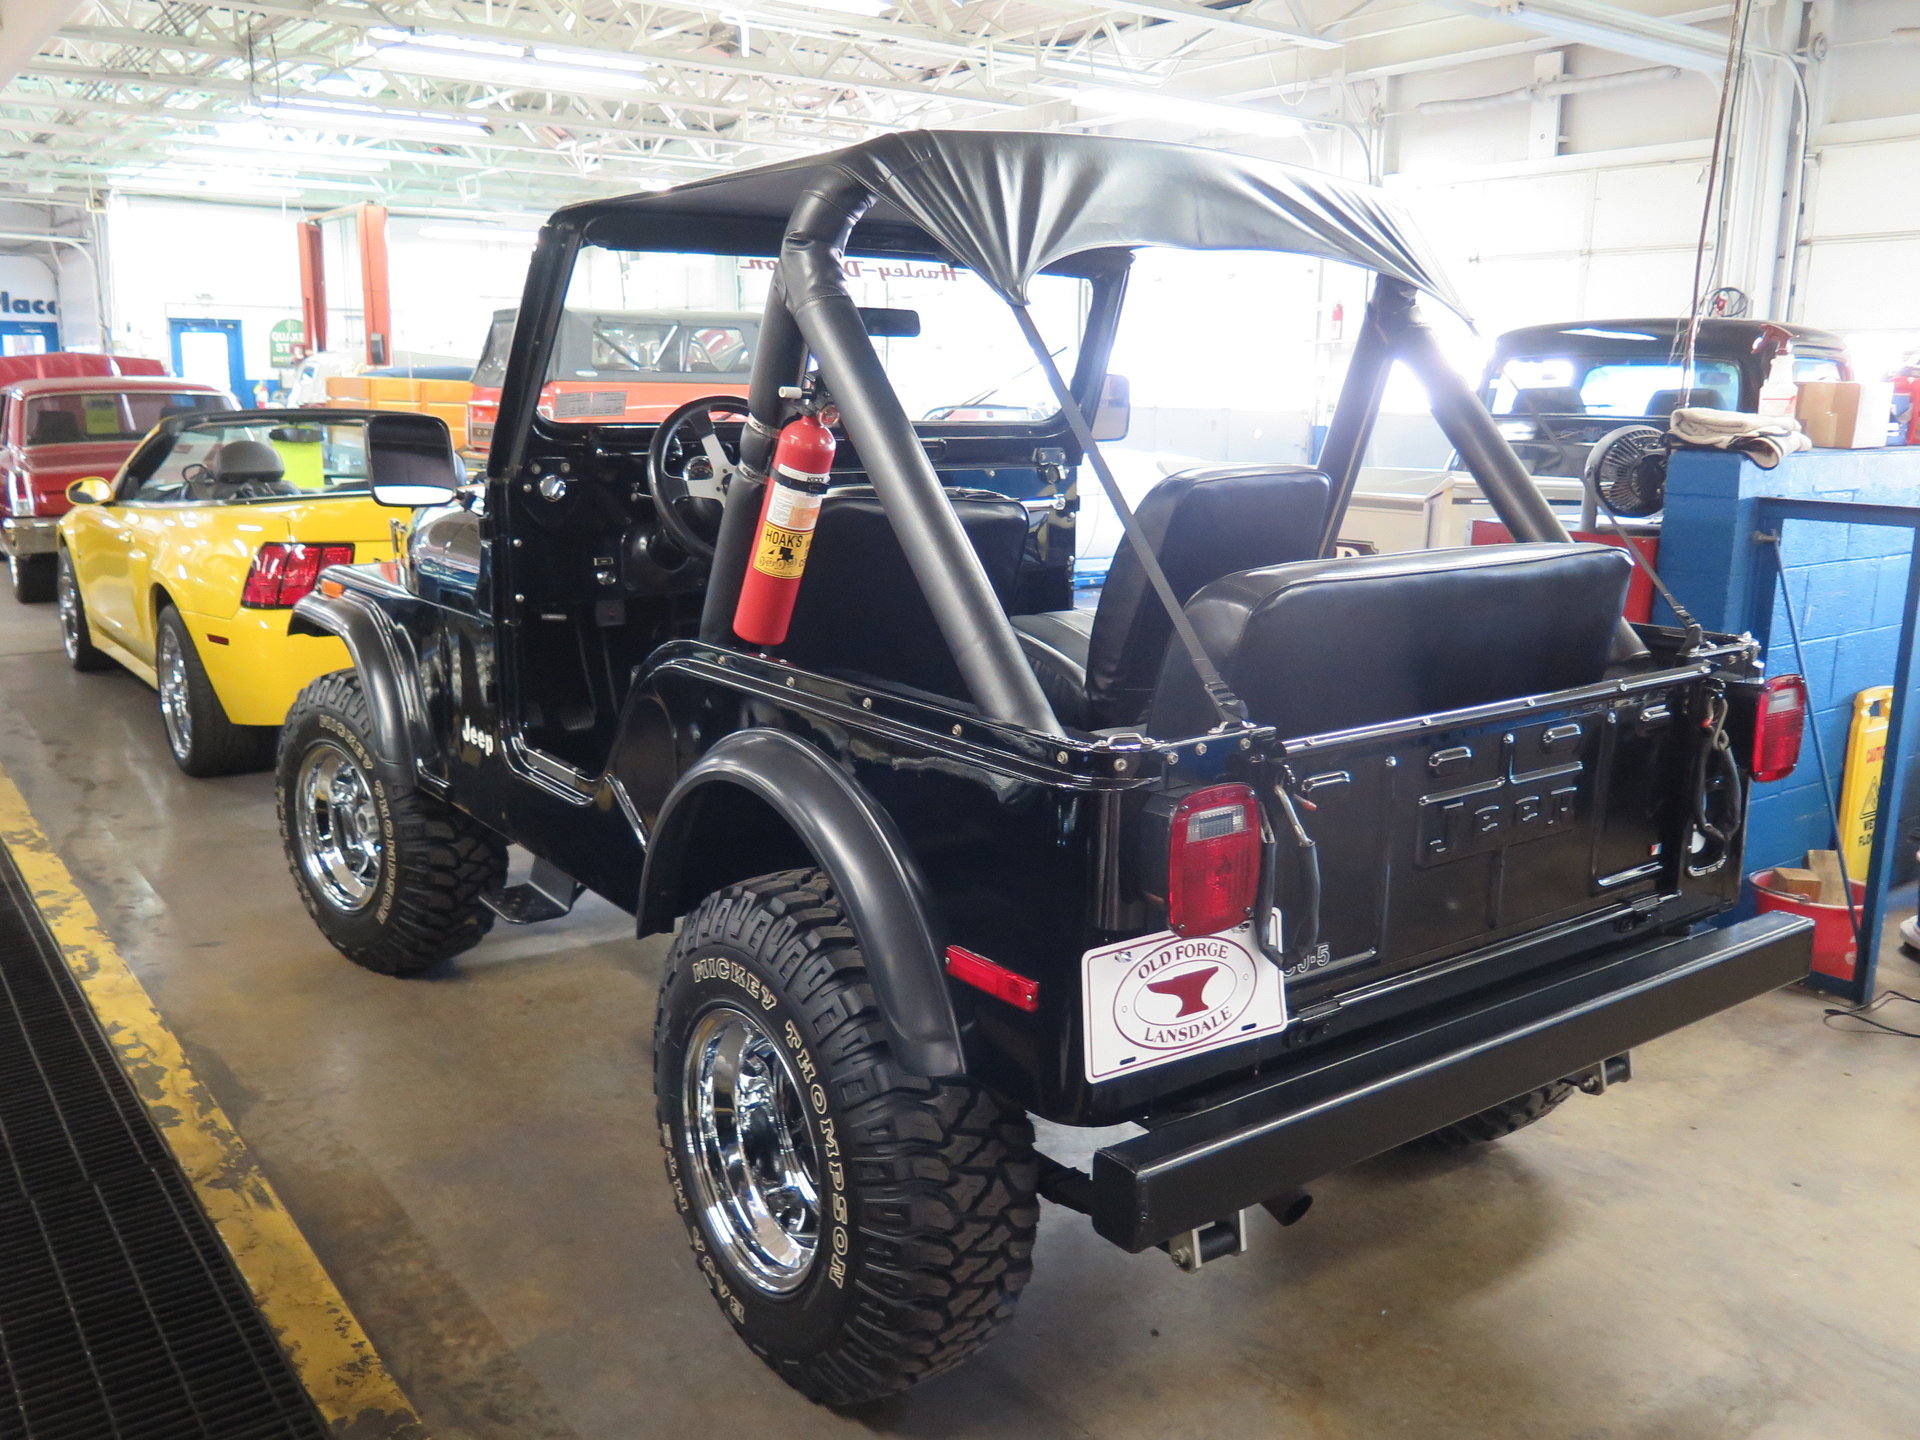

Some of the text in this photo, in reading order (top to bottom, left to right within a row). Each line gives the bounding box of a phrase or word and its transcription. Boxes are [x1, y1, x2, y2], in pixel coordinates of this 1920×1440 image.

[765, 528, 804, 548] HOAK'S
[462, 717, 495, 757] Jeep
[1857, 833, 1873, 846] FLO
[1863, 819, 1875, 831] WE
[1138, 942, 1229, 980] OLD FORGE
[1144, 1005, 1233, 1043] LANSDALE
[692, 957, 849, 1290] MICKEY THOMPSON
